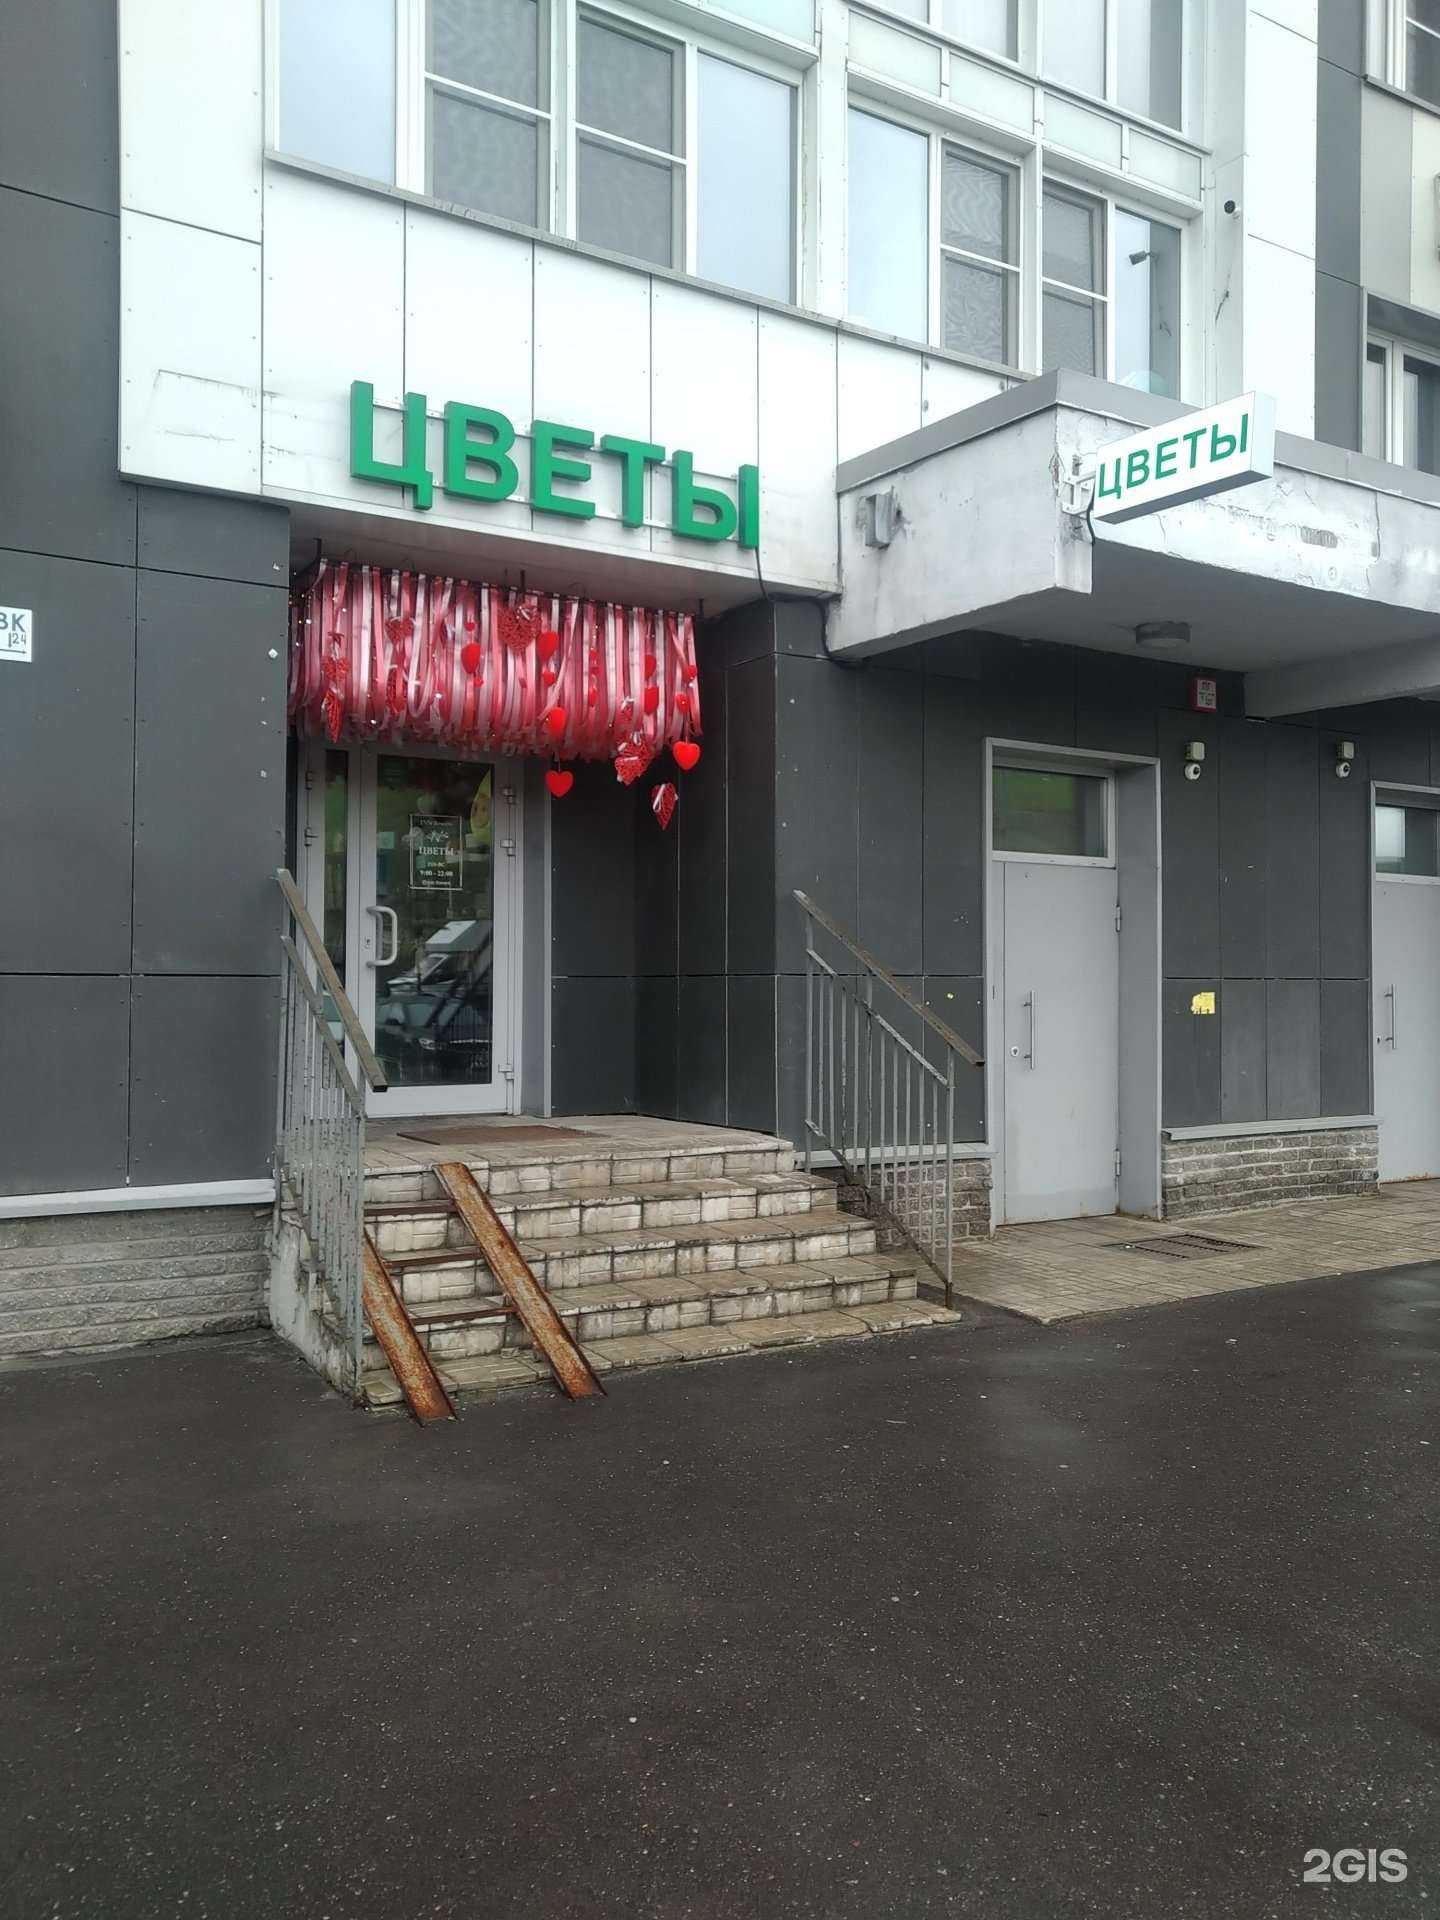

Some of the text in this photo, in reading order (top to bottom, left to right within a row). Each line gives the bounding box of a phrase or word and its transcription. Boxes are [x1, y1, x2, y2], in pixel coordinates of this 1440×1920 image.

[350, 379, 760, 549] ЦВЕТЫ
[1098, 413, 1249, 500] ЦВЕТЫ
[418, 846, 454, 856] ЦВЕТЫ
